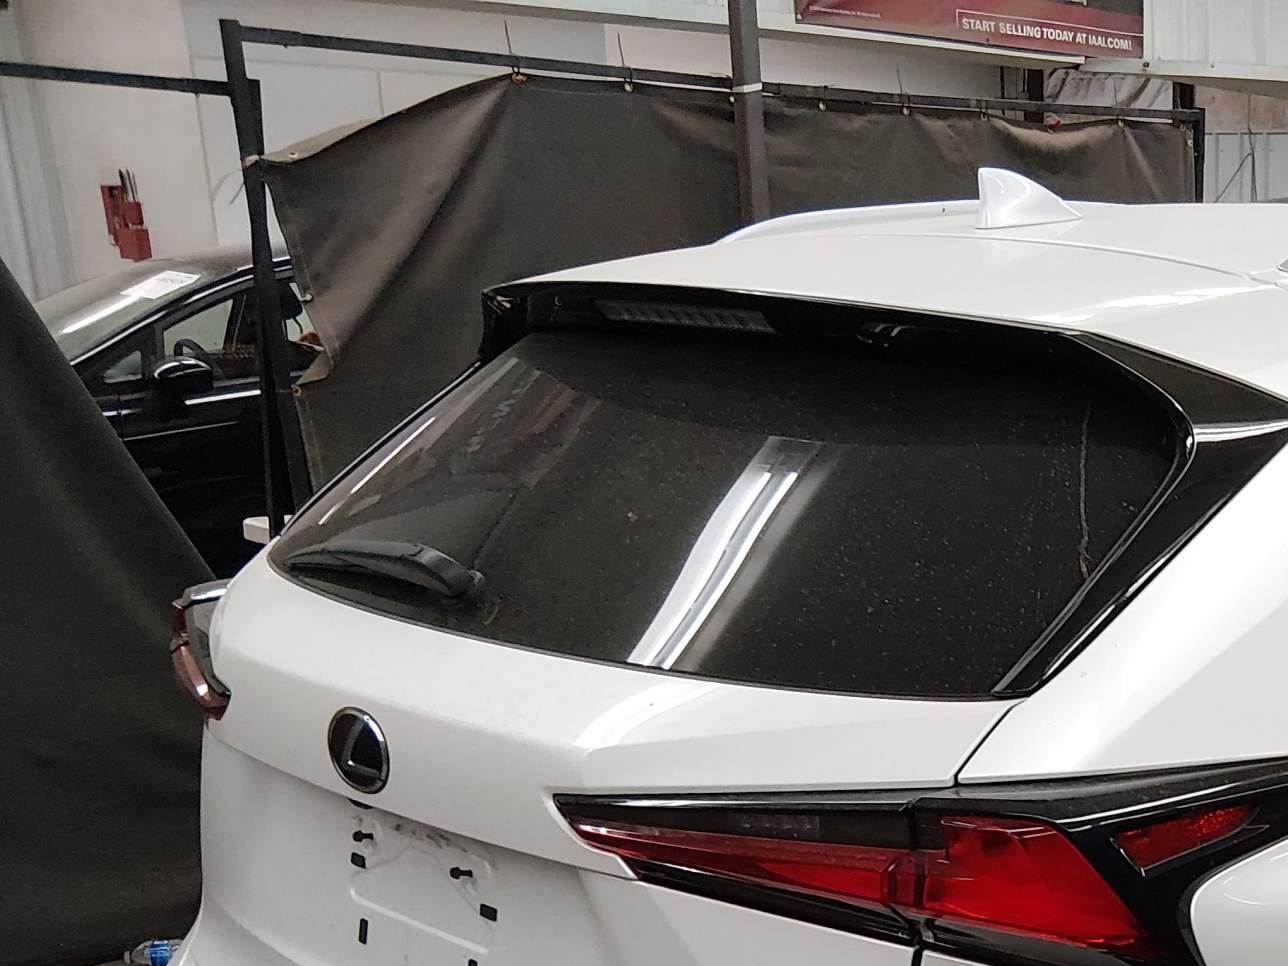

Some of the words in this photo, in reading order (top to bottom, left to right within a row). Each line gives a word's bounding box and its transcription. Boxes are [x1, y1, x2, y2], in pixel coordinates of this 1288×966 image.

[962, 18, 996, 32] START
[999, 21, 1041, 39] SELLING
[1042, 28, 1074, 42] TODAY
[1075, 32, 1087, 45] AT
